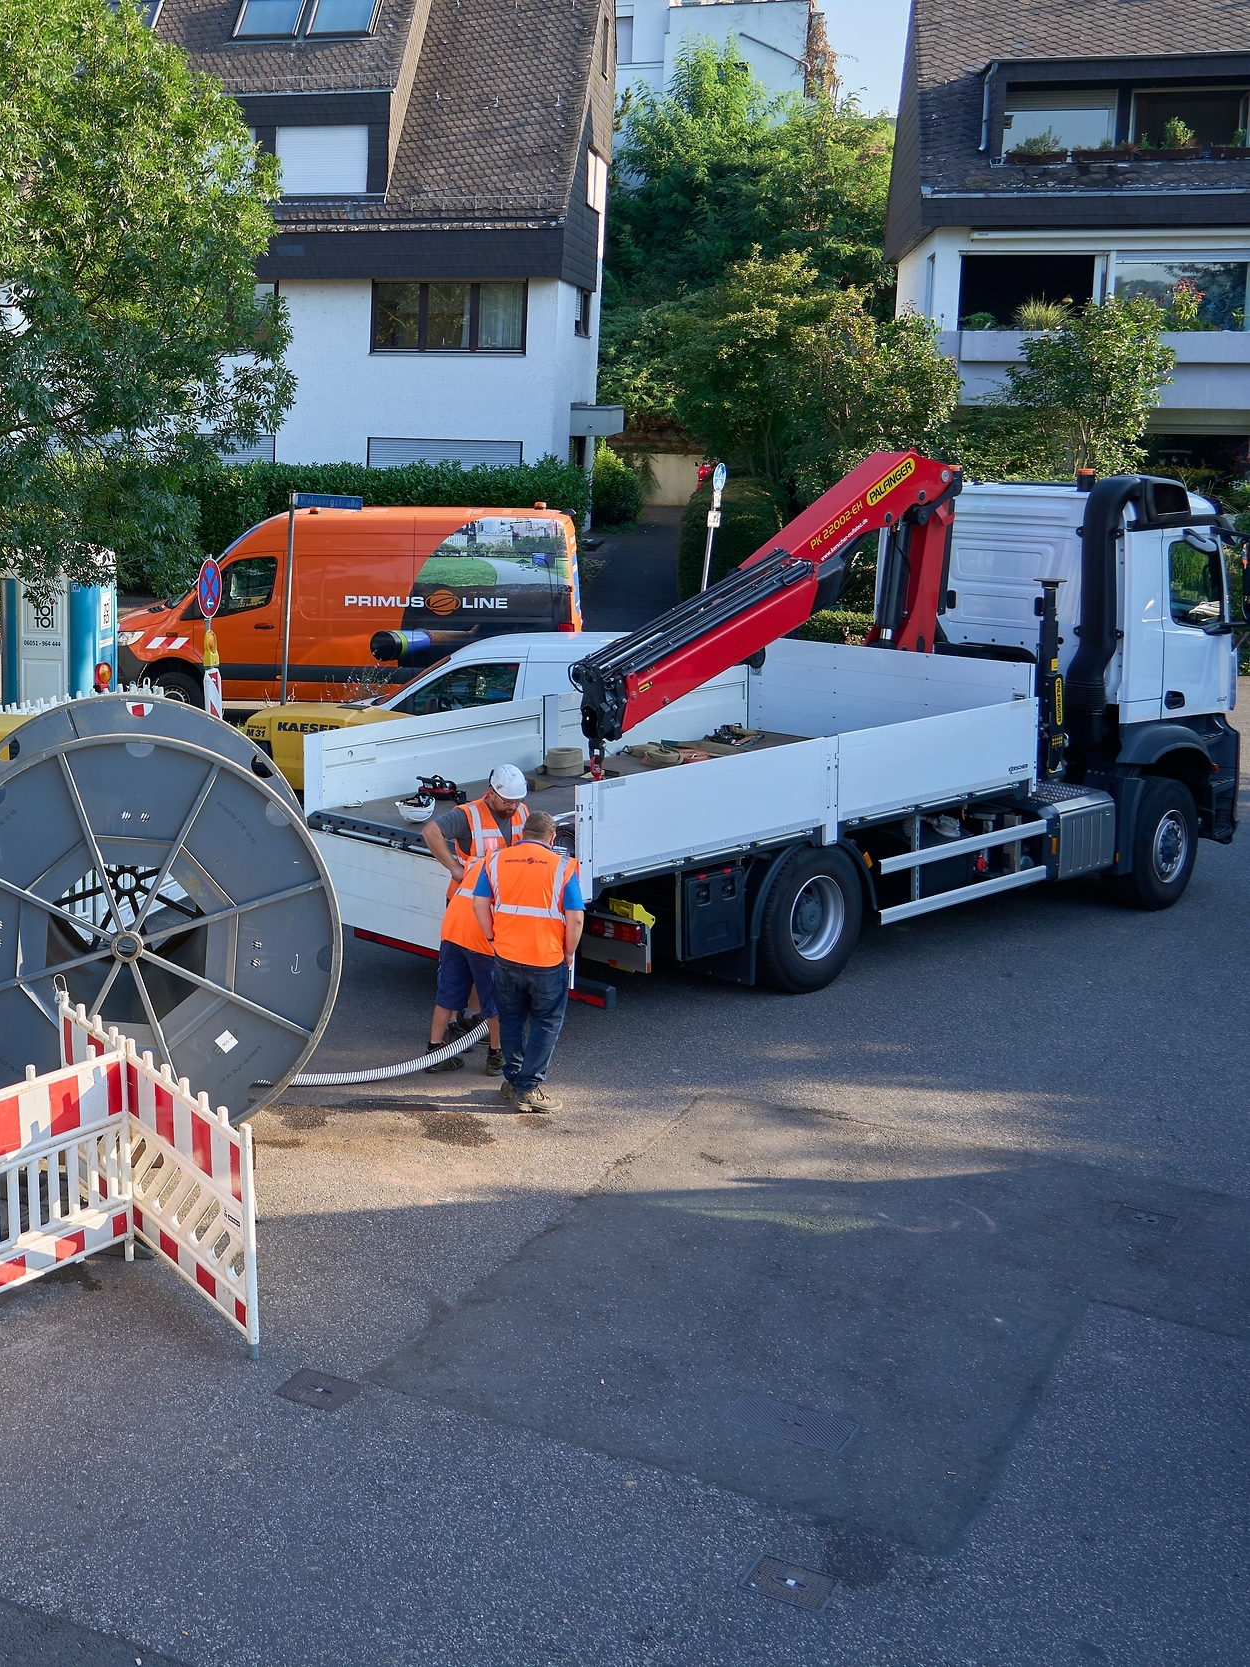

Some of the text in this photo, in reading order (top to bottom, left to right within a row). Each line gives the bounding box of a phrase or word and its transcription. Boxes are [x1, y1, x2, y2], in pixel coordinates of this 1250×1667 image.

[869, 461, 913, 503] PALFINGER
[300, 495, 359, 508] Weinbergstraße
[810, 534, 823, 550] PK
[345, 595, 508, 609] PRIMUS LINE
[34, 616, 54, 628] TOI
[255, 729, 266, 738] 31
